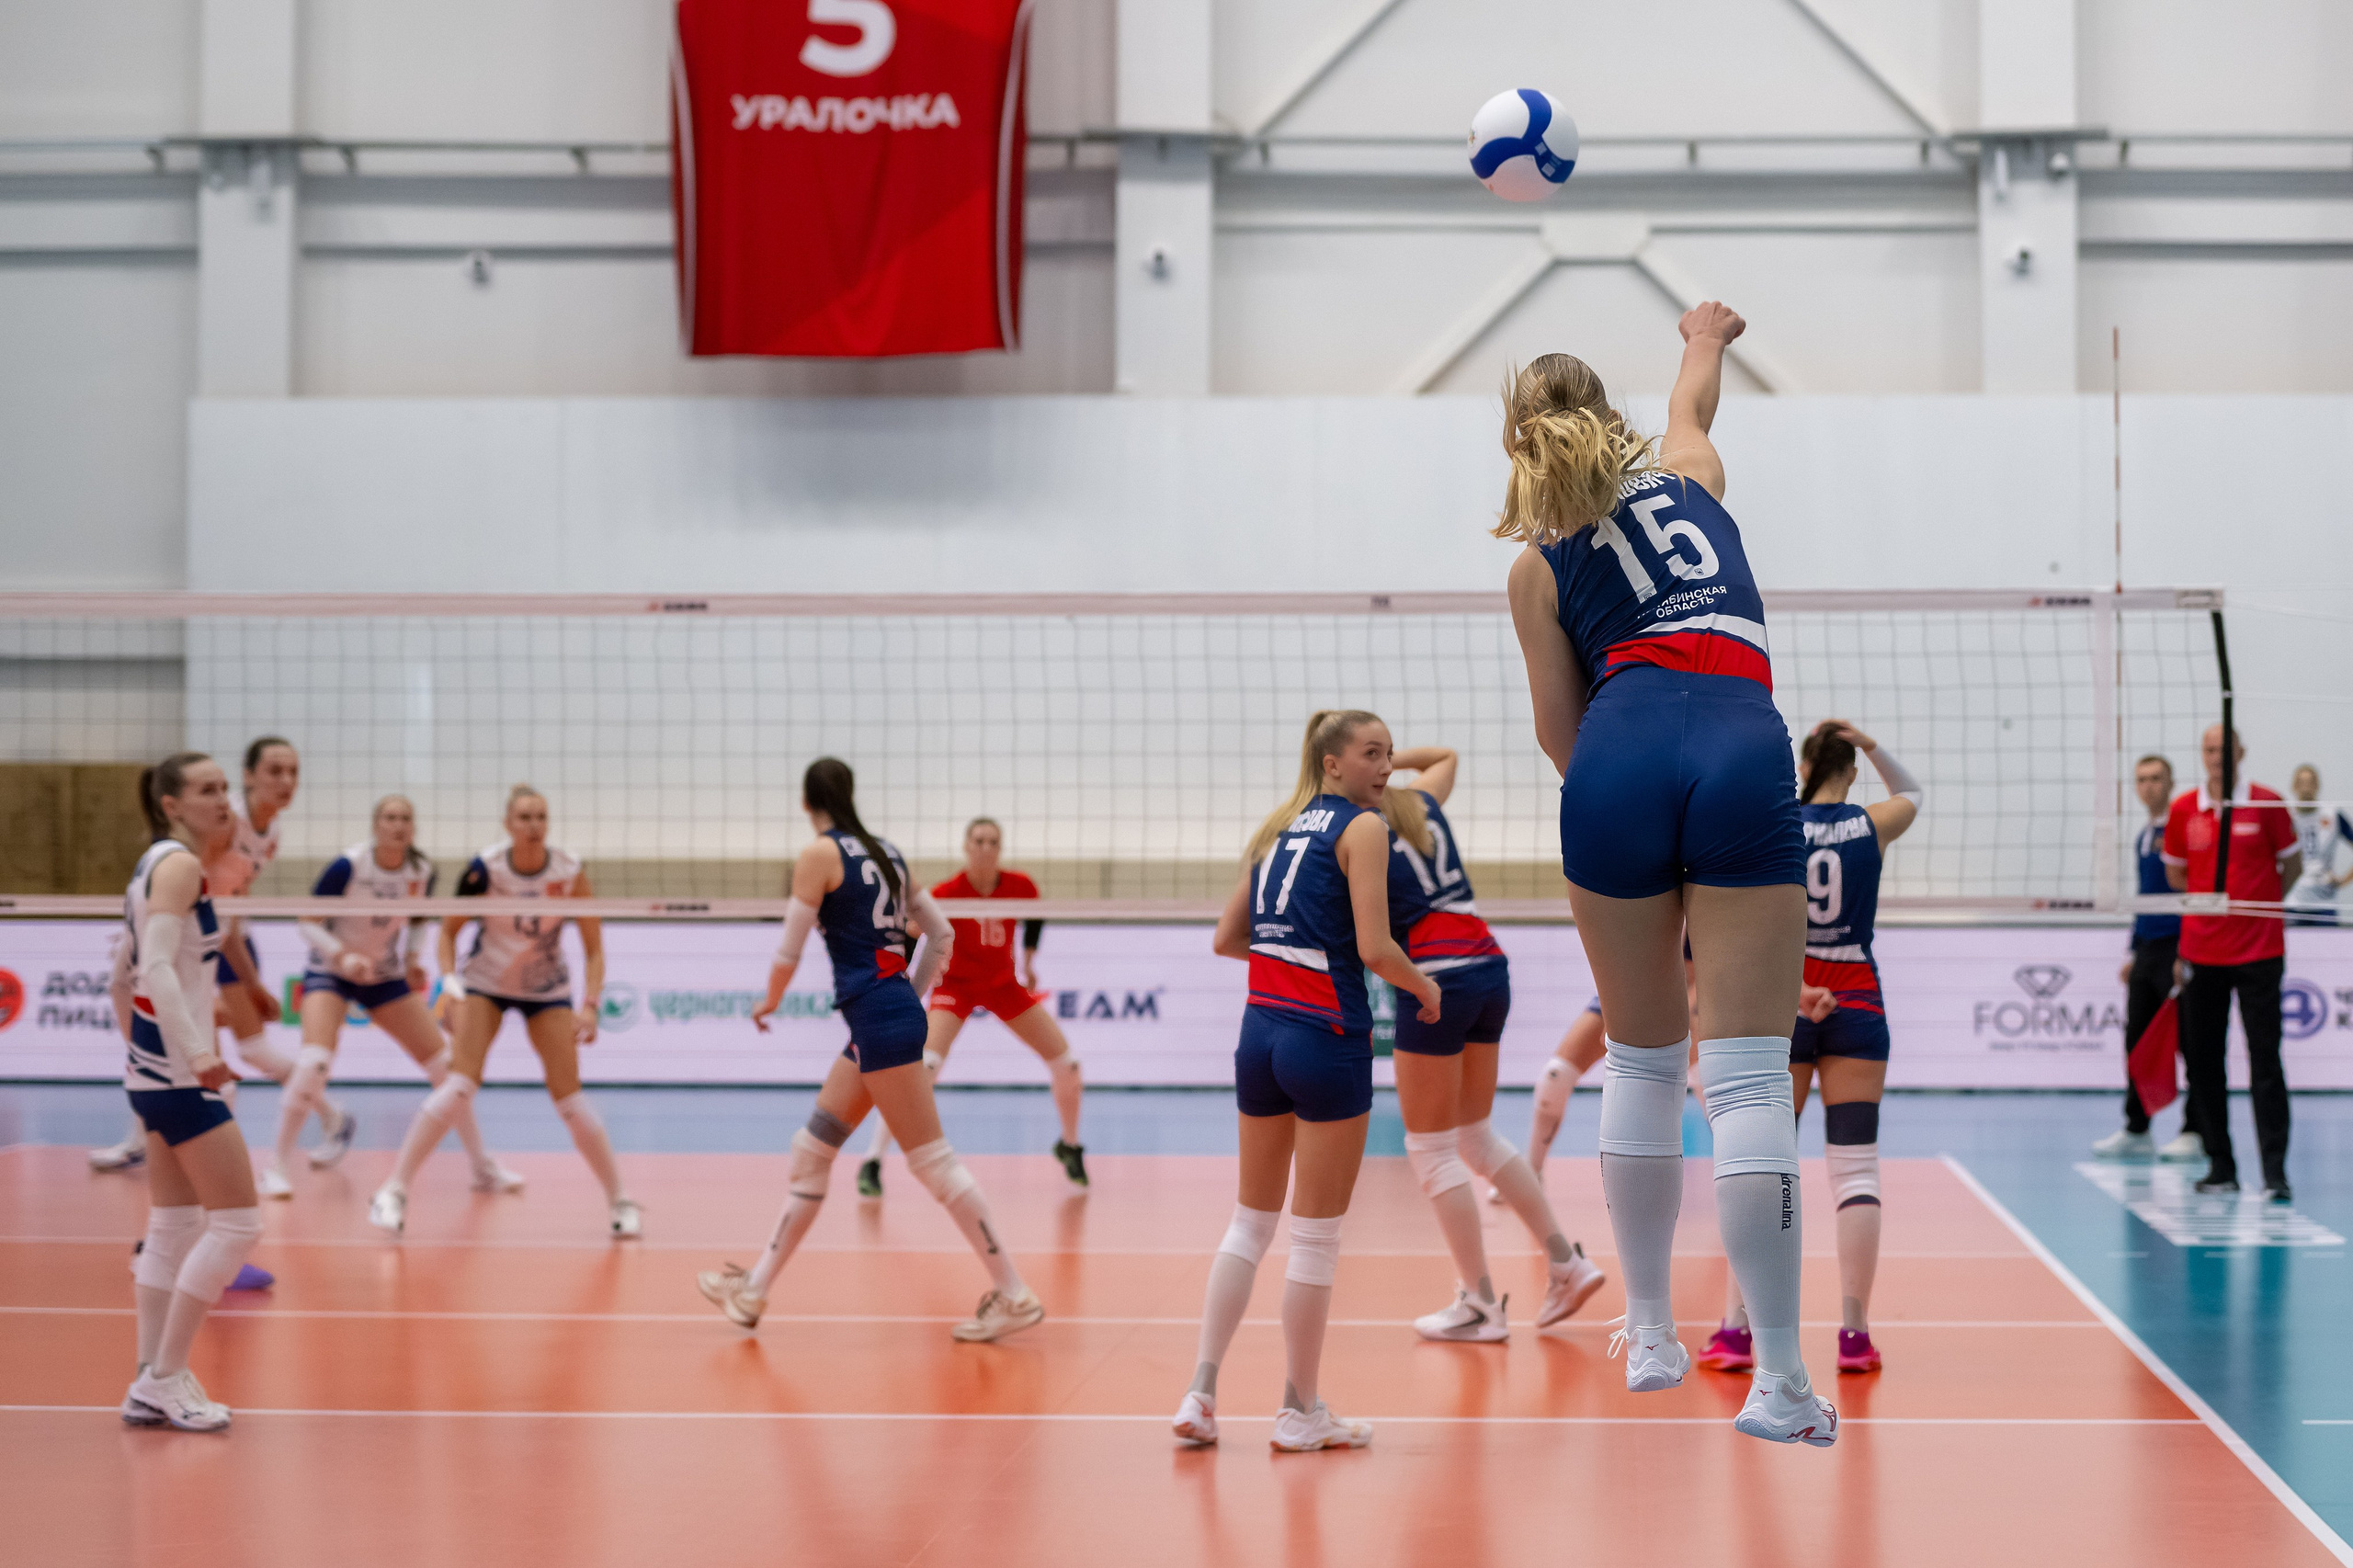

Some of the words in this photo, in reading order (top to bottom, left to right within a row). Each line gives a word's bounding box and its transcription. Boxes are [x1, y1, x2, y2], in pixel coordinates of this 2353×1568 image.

[798, 0, 897, 77] 5
[731, 93, 960, 132] УРАЛОЧКА
[1591, 494, 1720, 605] 15
[1655, 597, 1715, 619] ОБЛАСТЬ
[1256, 837, 1311, 915] 17
[1392, 819, 1462, 896] 12
[1806, 848, 1843, 925] 9
[41, 971, 111, 997] ДОД
[1058, 990, 1159, 1019] EAM
[38, 1005, 113, 1029] ПИЦ
[1973, 1001, 2128, 1037] FORMA
[1780, 1173, 1793, 1232] drenalina
